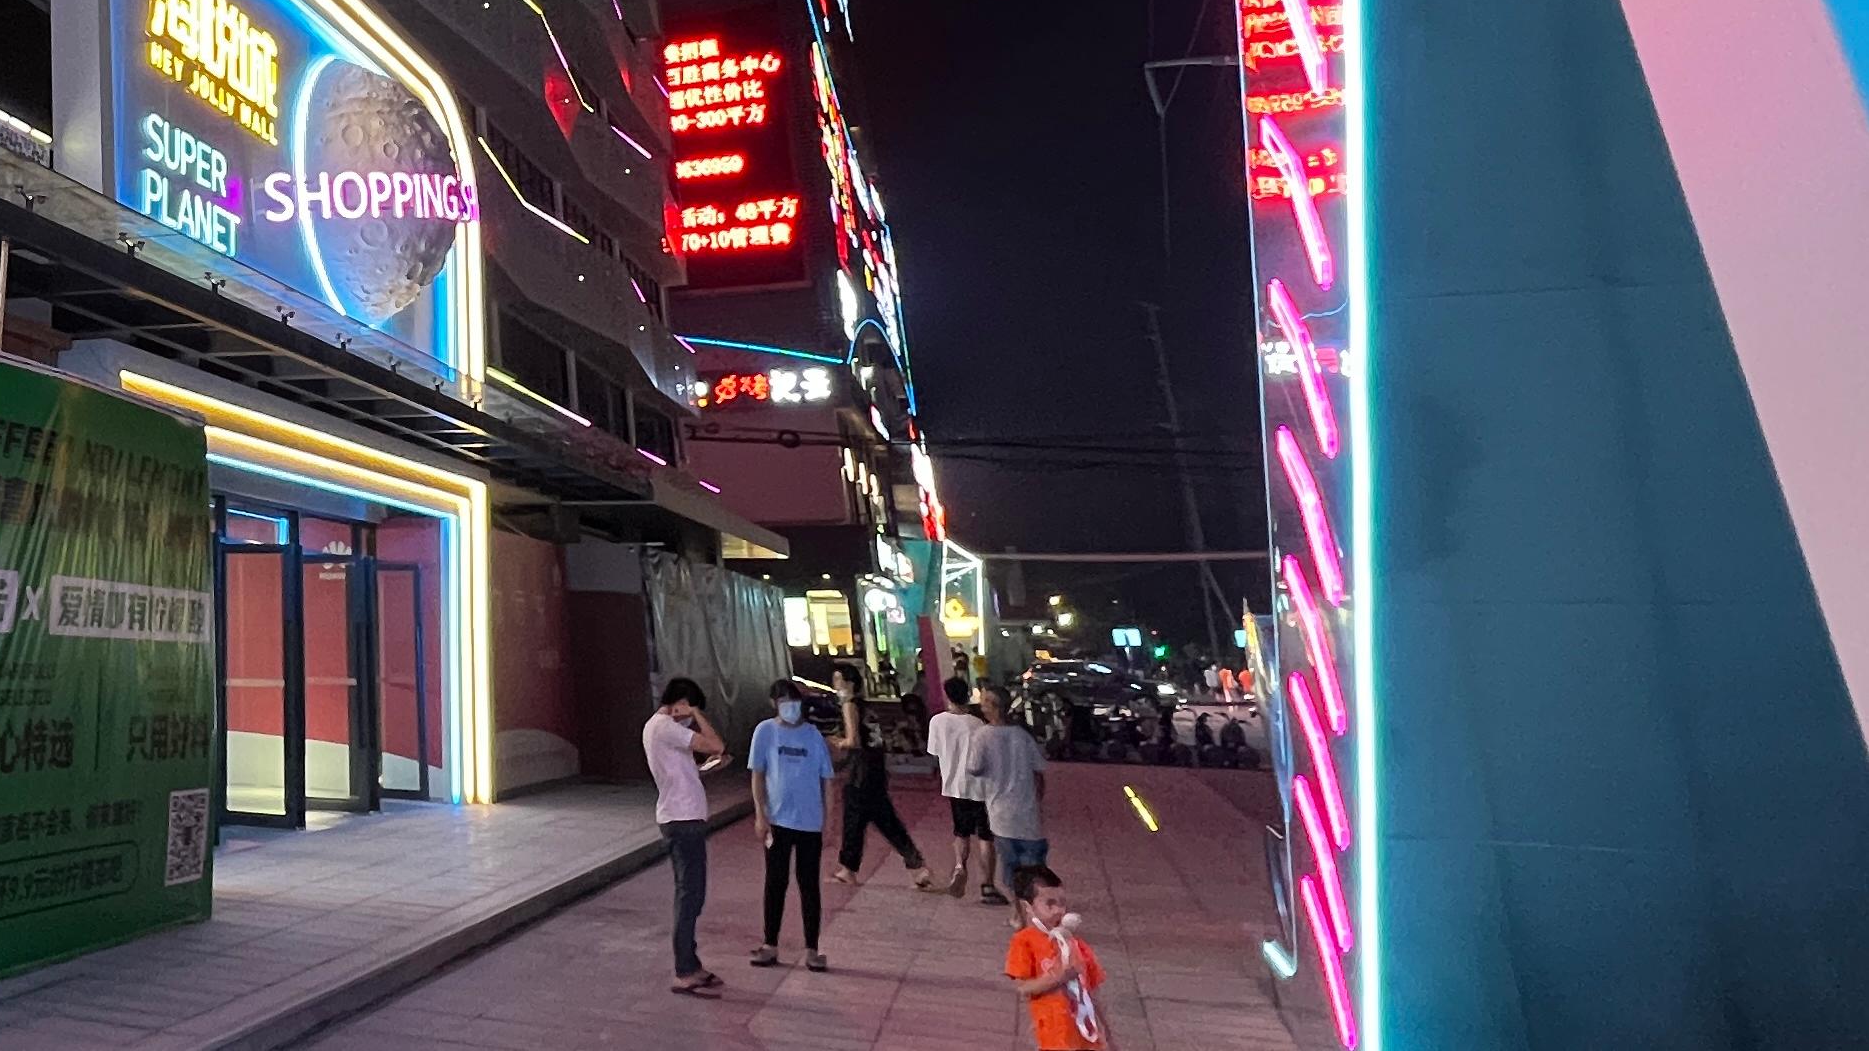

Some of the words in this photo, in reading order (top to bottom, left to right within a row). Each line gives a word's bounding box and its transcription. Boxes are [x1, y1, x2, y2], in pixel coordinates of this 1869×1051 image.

[148, 40, 184, 83] HEY
[187, 66, 236, 116] JOLLY
[239, 101, 279, 147] MALL
[143, 112, 228, 198] SUPER
[141, 168, 242, 257] PLANET
